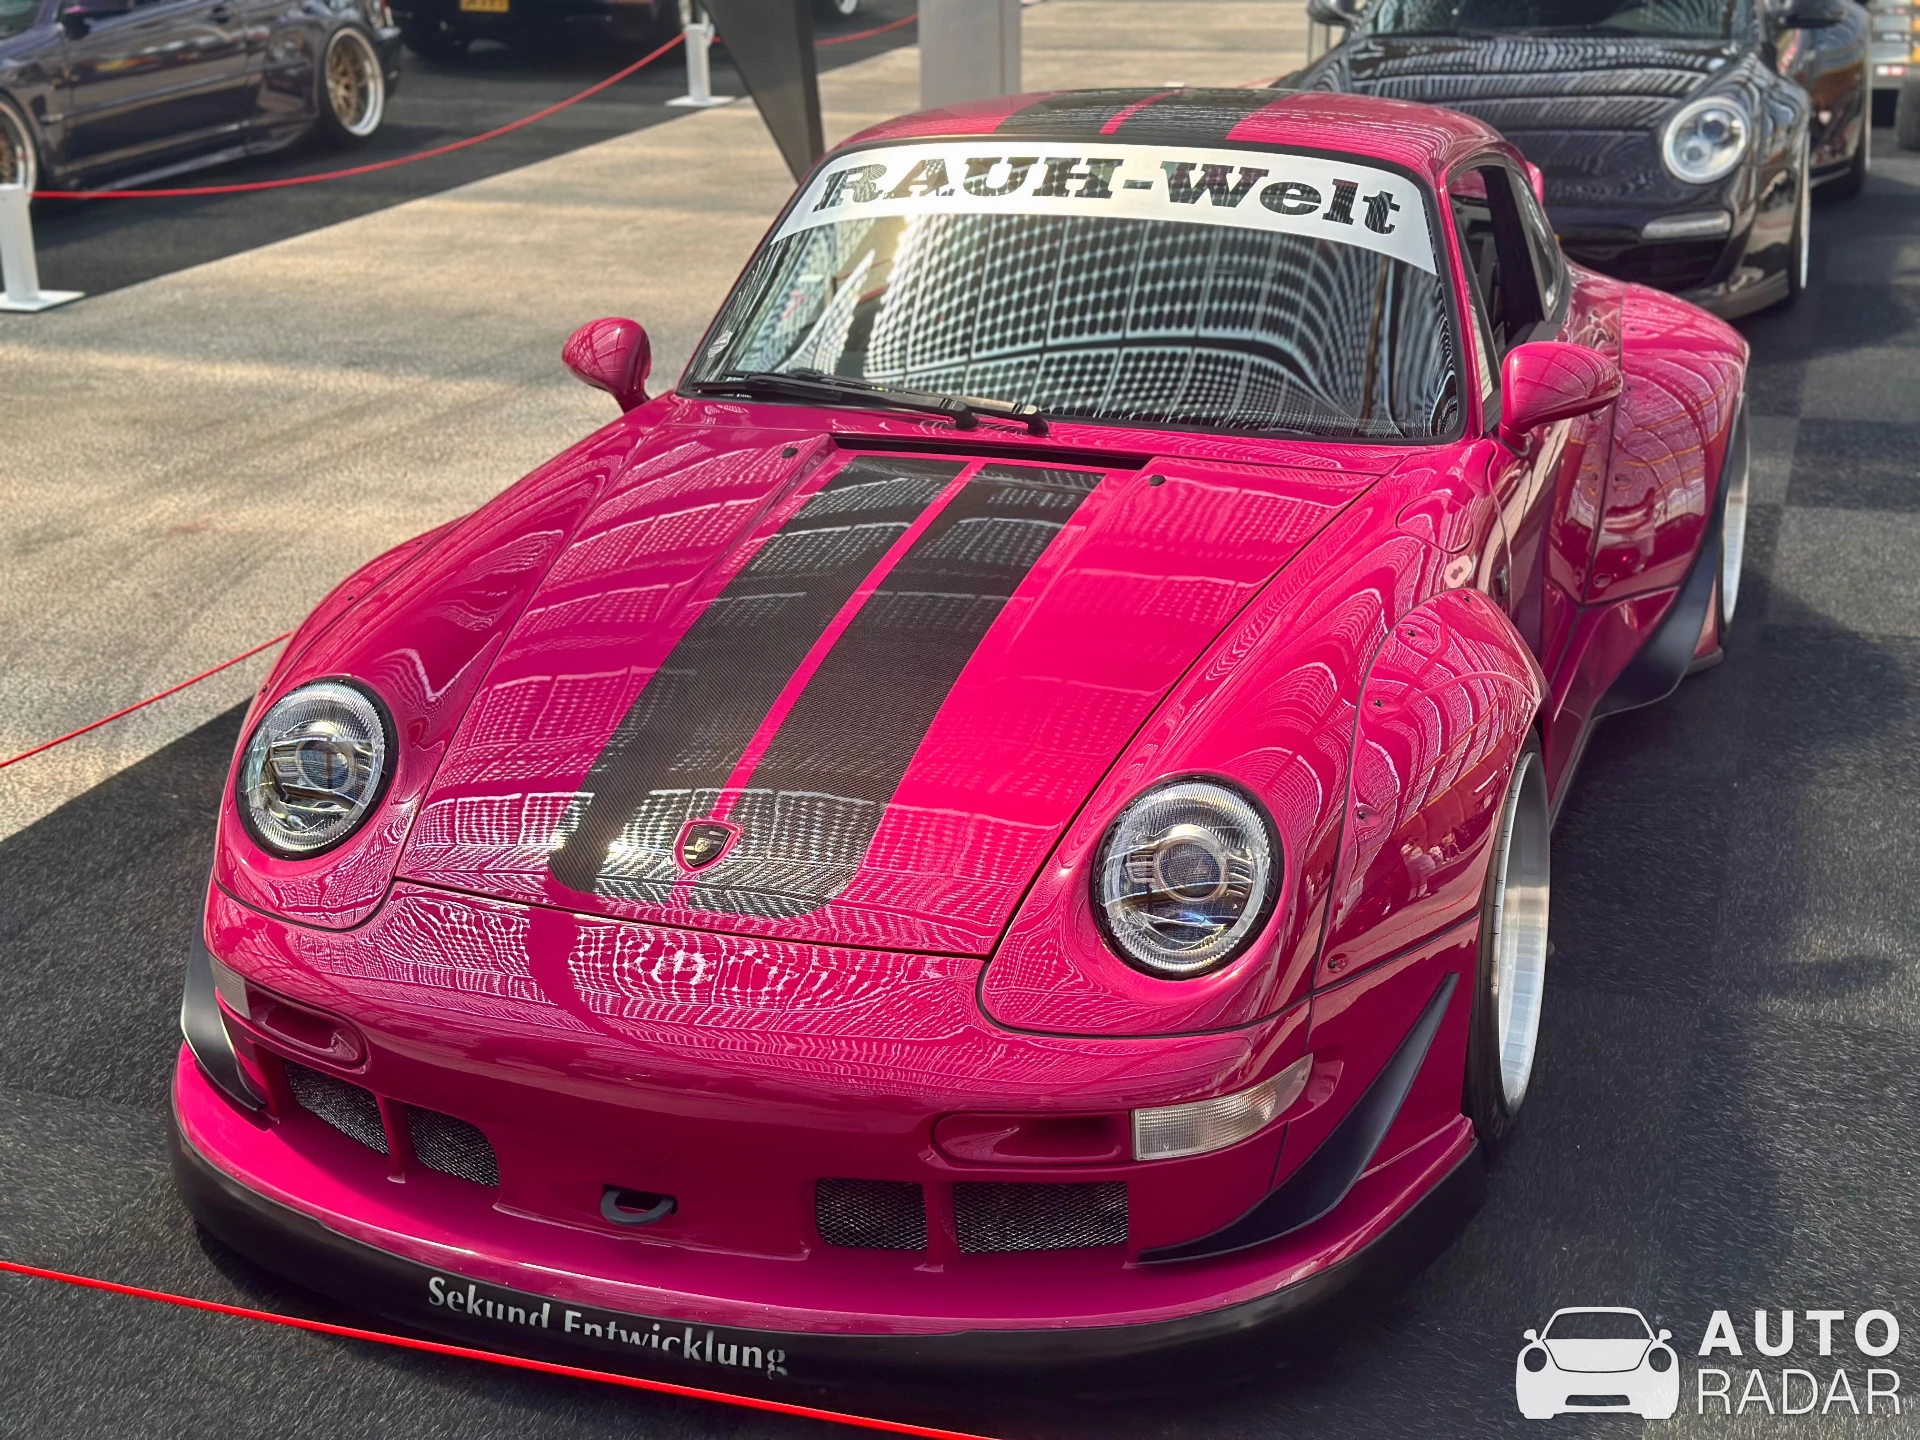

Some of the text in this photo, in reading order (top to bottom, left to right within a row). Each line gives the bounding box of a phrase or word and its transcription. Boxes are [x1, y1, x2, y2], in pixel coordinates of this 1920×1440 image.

[812, 156, 1400, 235] RAUH-Welt
[428, 1276, 788, 1380] Sekund Entwicklung
